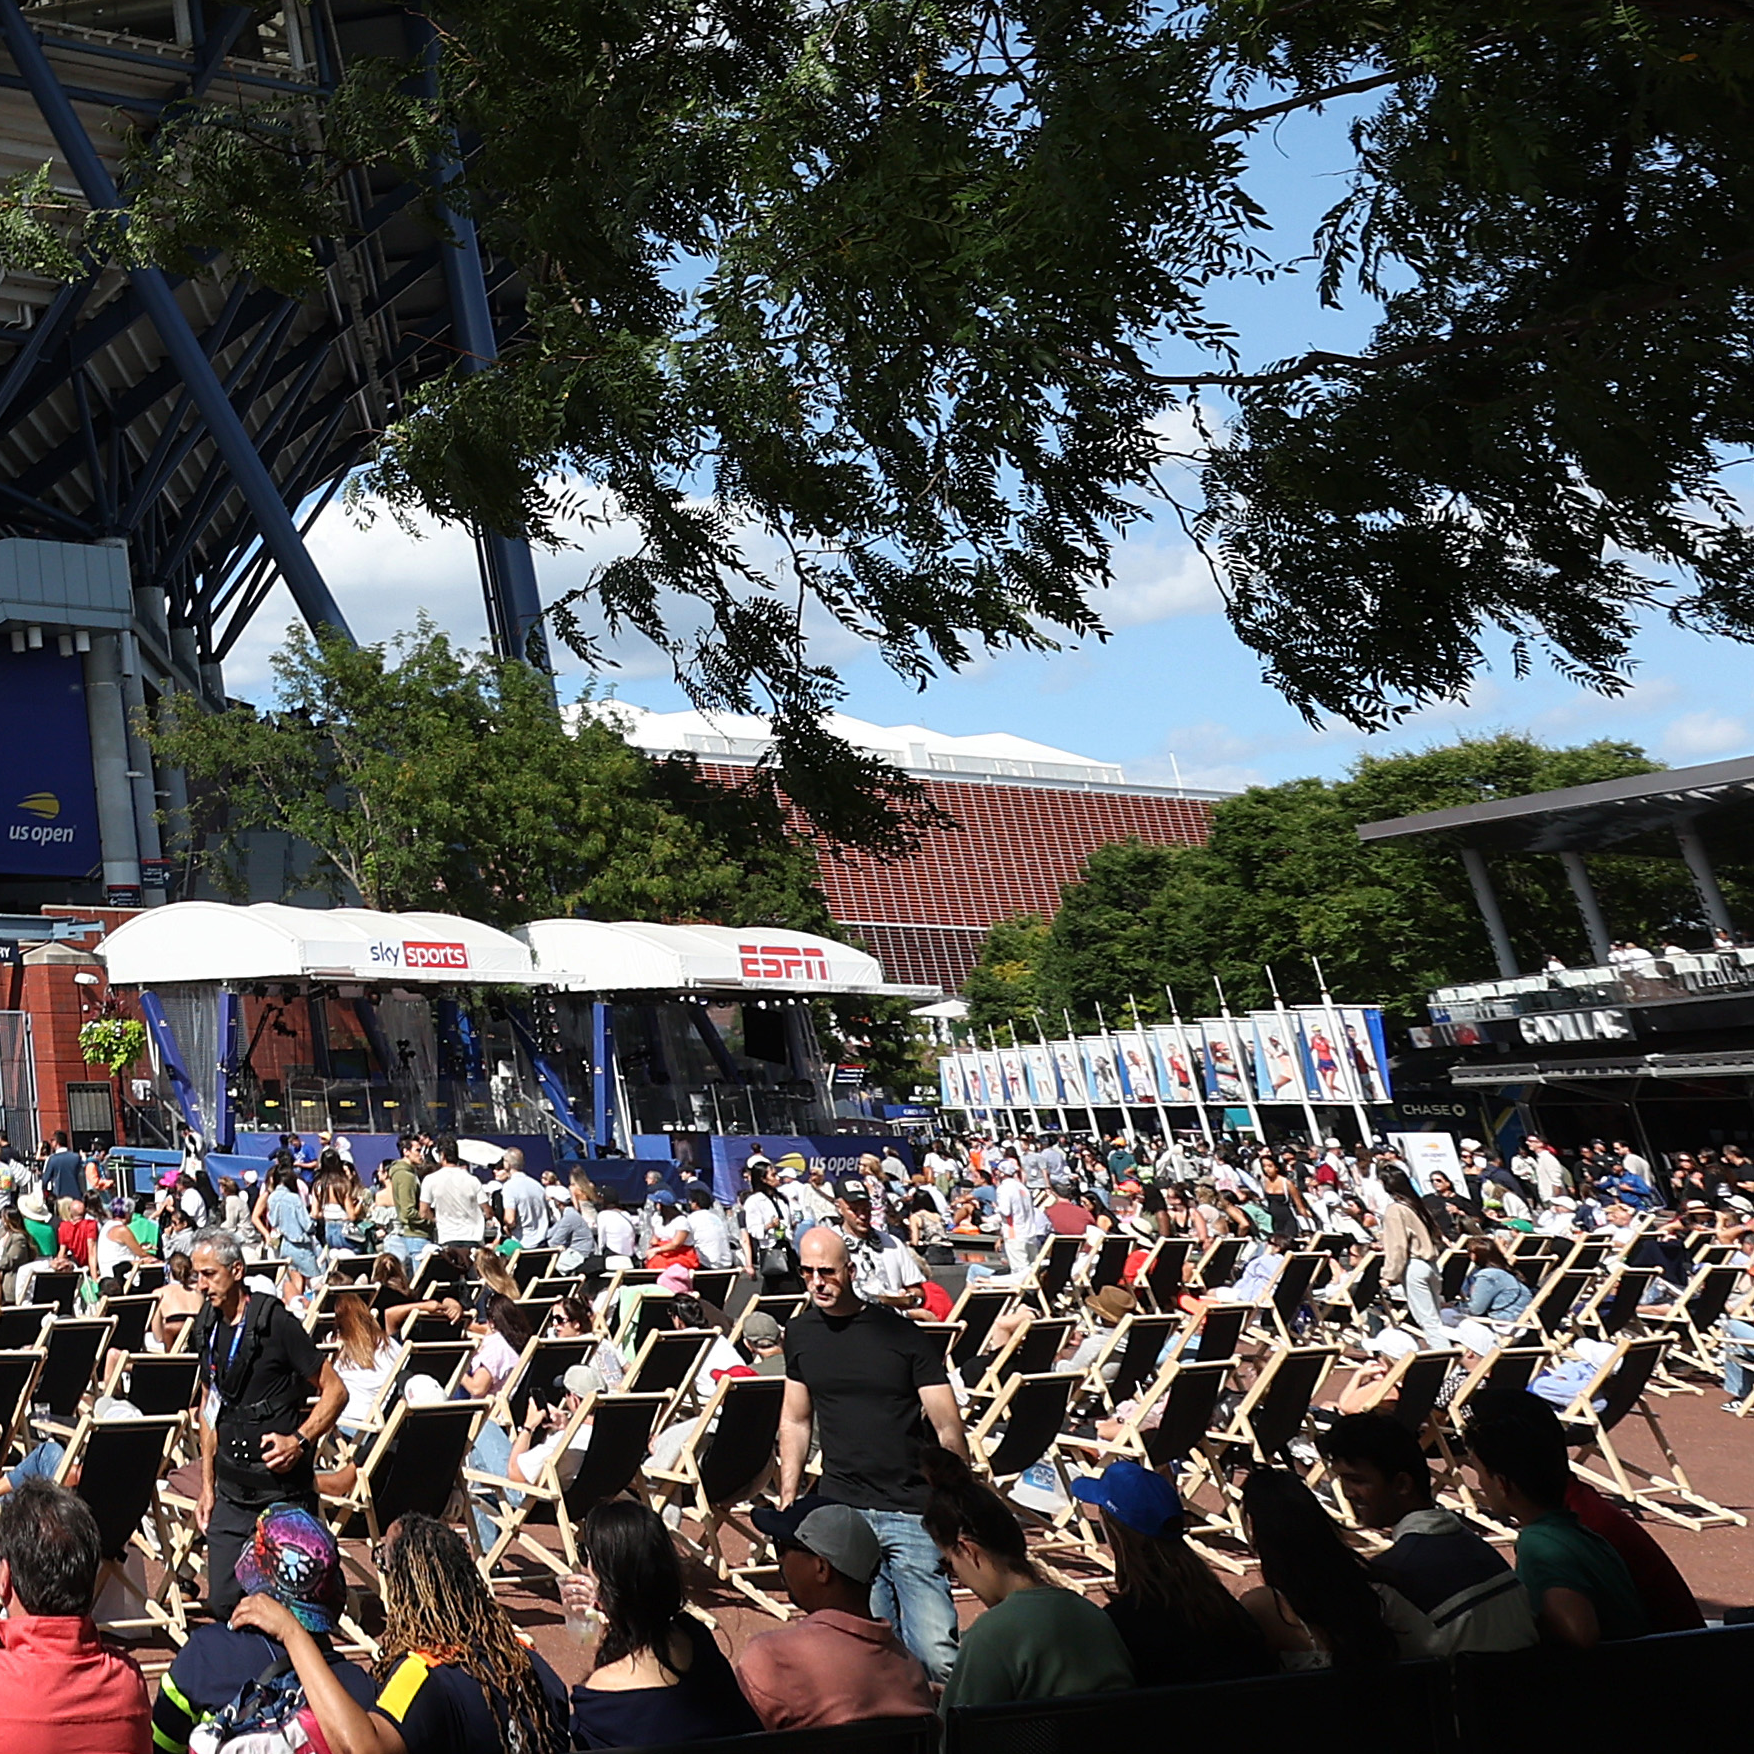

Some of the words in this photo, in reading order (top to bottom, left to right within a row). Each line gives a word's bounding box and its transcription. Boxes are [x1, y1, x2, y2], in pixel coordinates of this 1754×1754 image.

[8, 825, 29, 841] us
[31, 826, 75, 846] open
[370, 940, 400, 968] sky
[405, 943, 466, 968] sports
[738, 944, 830, 981] ESPN
[1402, 1104, 1452, 1116] CHASE
[809, 1156, 826, 1170] us
